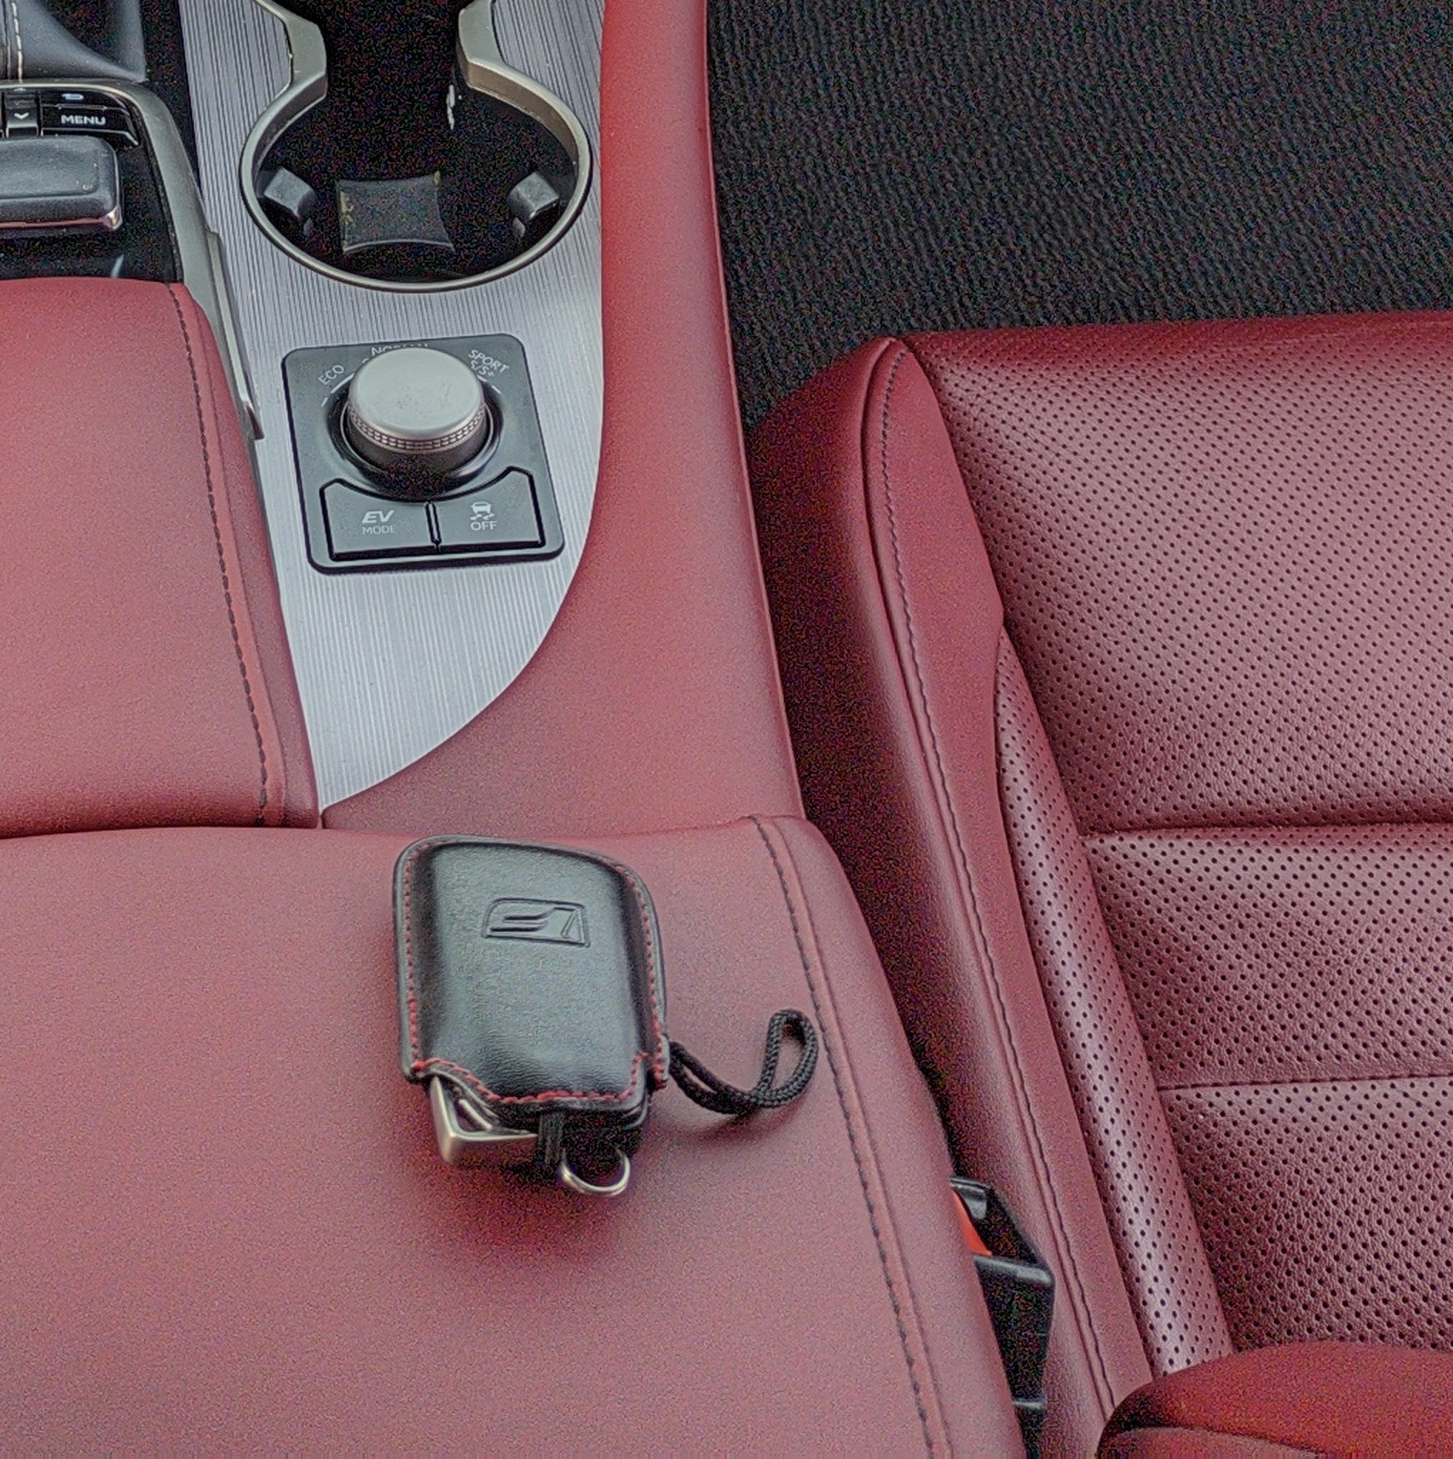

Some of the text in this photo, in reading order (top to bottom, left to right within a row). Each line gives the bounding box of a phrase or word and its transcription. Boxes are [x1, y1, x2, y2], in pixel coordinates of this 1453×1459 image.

[61, 114, 106, 126] MENU
[467, 349, 509, 373] SPORT
[318, 364, 345, 385] ECO
[362, 509, 394, 524] EV
[470, 521, 497, 531] OFF
